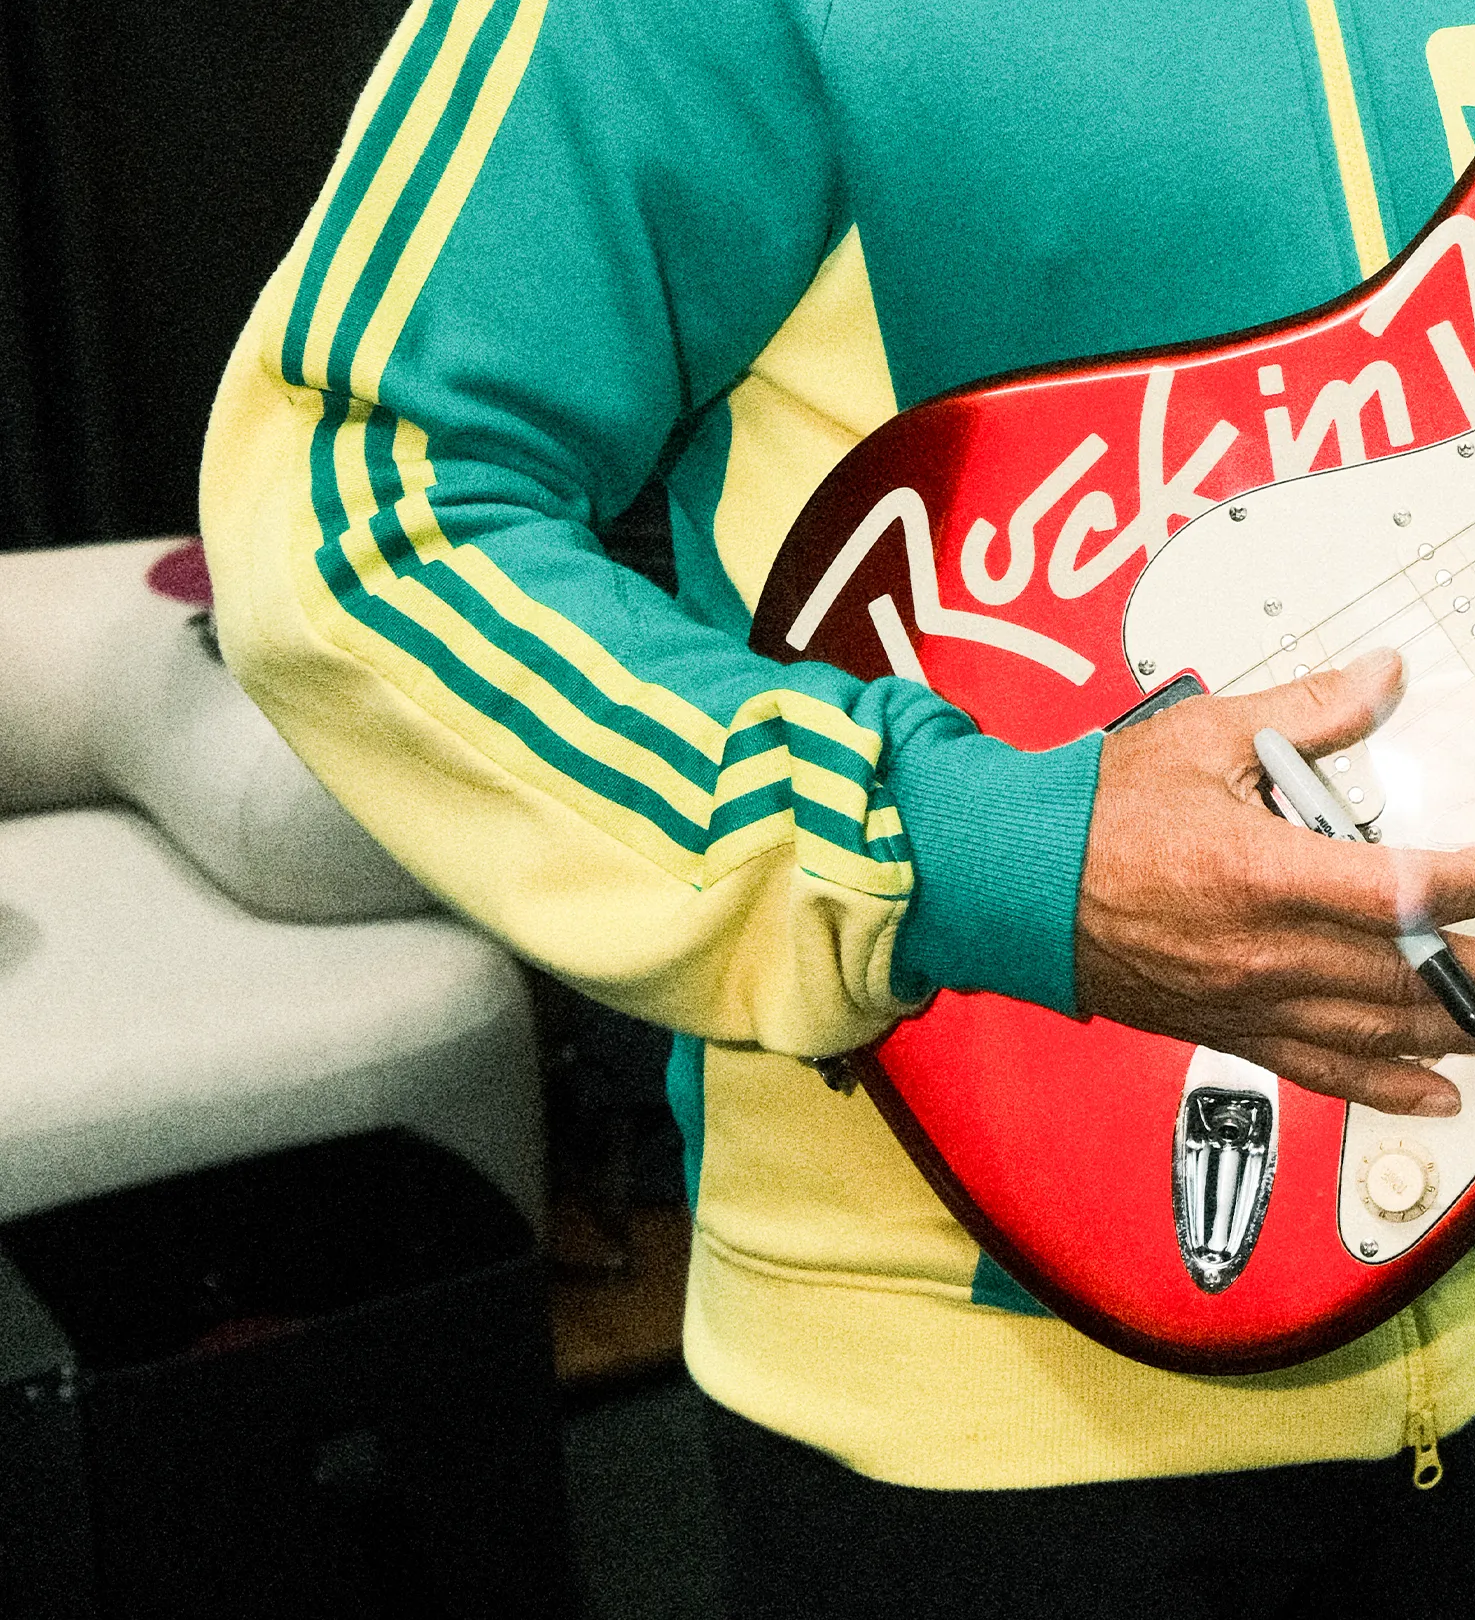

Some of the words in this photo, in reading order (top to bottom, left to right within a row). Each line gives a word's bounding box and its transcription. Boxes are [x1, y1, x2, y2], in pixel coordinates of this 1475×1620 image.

[786, 365, 1240, 686] Rock
[1257, 363, 1415, 482] in
[1314, 814, 1336, 838] POINT
